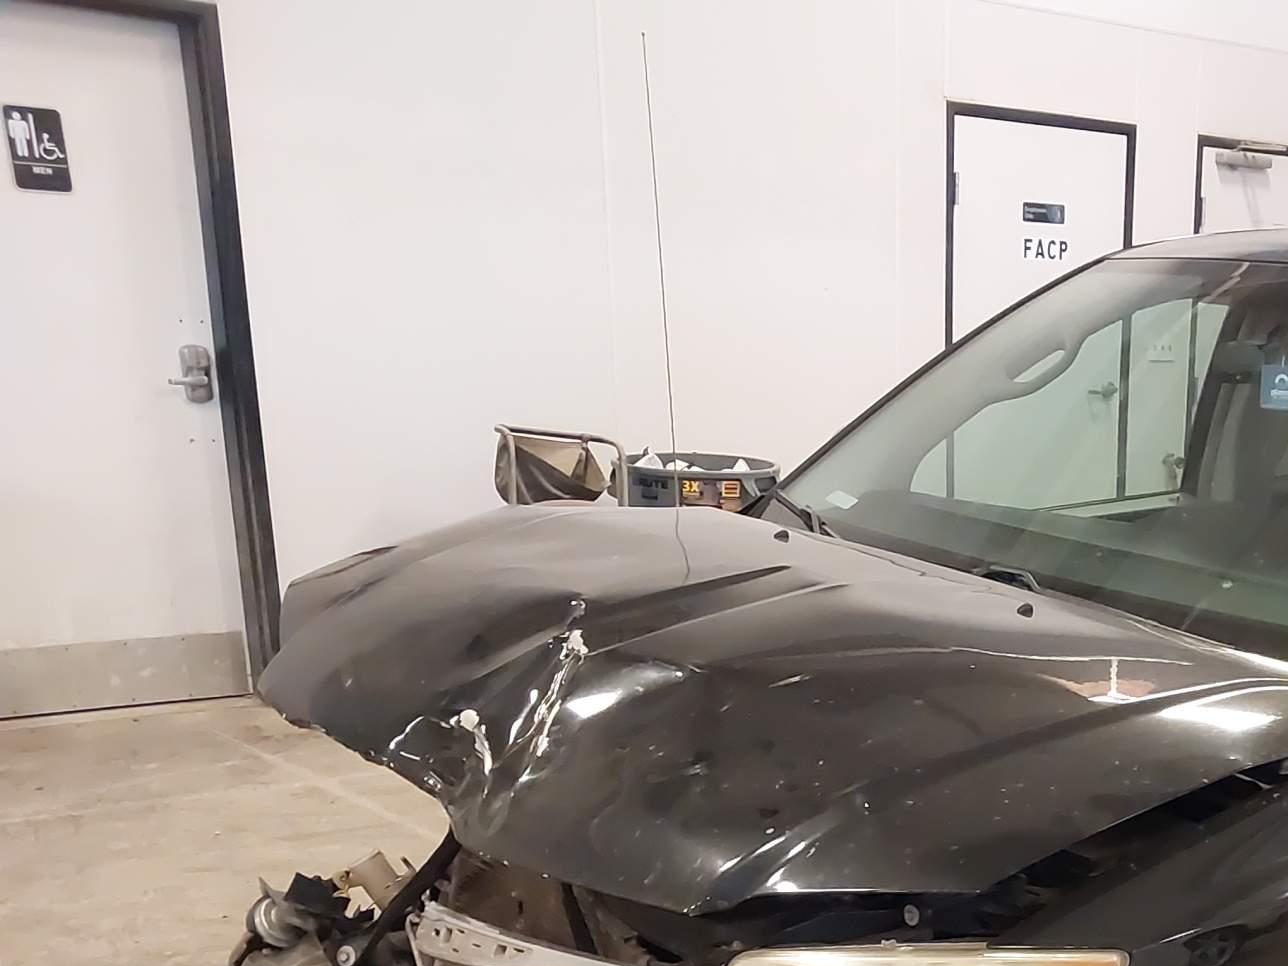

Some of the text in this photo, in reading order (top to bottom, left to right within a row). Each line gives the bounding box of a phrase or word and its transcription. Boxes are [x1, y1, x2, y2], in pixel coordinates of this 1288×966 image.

[32, 166, 53, 175] MEN
[1023, 238, 1068, 261] FACP
[682, 480, 700, 492] 3X
